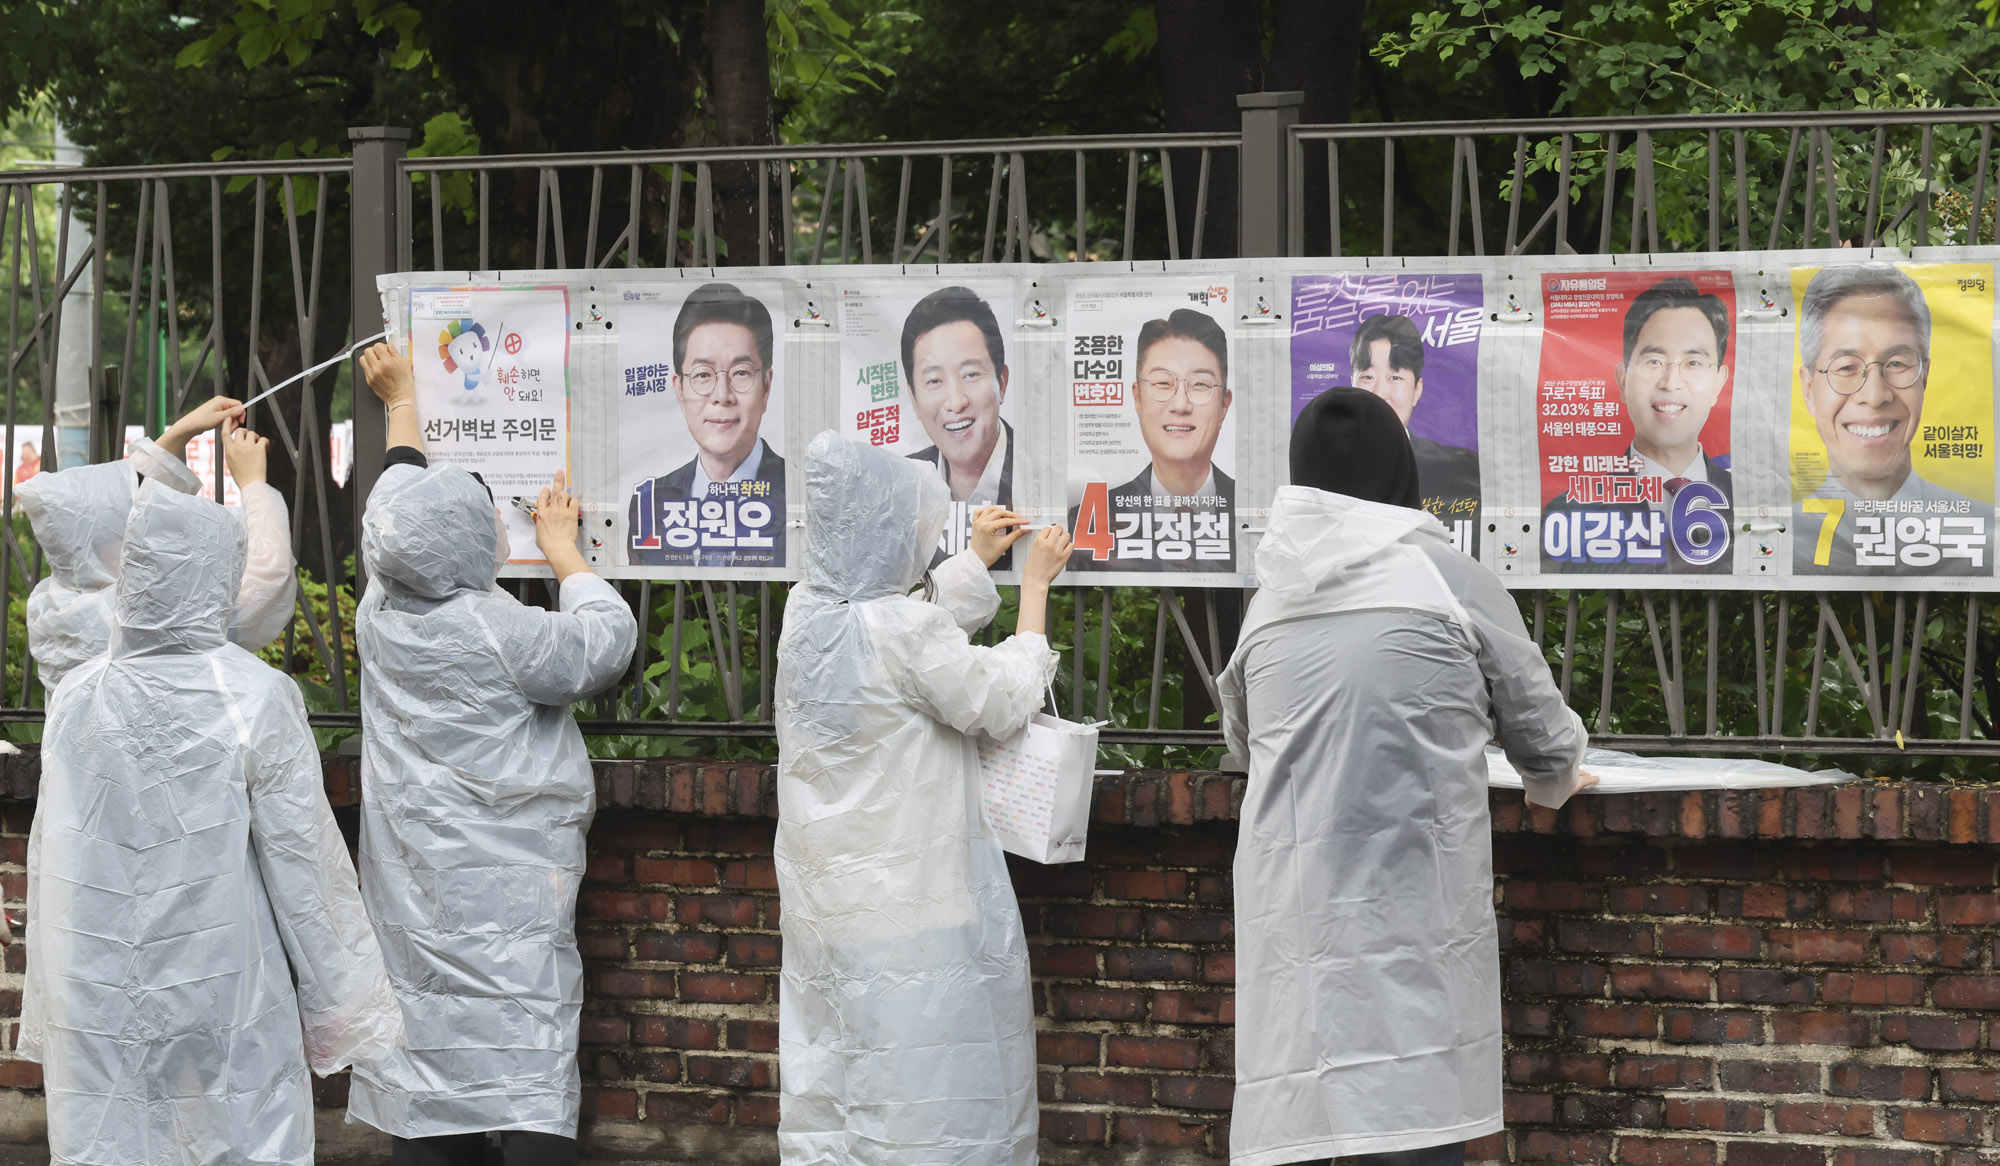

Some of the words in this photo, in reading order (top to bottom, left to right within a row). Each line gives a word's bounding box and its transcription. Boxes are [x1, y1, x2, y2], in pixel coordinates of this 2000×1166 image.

[1560, 278, 1607, 292] 자유통일당
[1957, 278, 1986, 291] 정의당
[1397, 275, 1456, 319] 없는
[1421, 306, 1483, 349] 서울
[1074, 335, 1123, 356] 조용한
[497, 366, 541, 384] 훼손하면
[625, 367, 635, 383] 일
[636, 363, 669, 381] 잘하는
[857, 361, 898, 386] 시작된
[1074, 360, 1122, 380] 다수의
[504, 387, 515, 402] 안
[518, 389, 543, 402] 돼요!
[625, 377, 667, 397] 서울시장
[871, 380, 900, 403] 변화
[1074, 384, 1122, 405] 변호인
[1542, 387, 1576, 401] 구로구
[1578, 387, 1606, 400] 득표!
[857, 404, 900, 431] 압도적
[1542, 403, 1590, 416] 32.03%
[1593, 402, 1620, 417] 돌풍!
[424, 419, 497, 442] 선거벽보
[502, 418, 557, 442] 주의문
[870, 424, 900, 447] 완성
[1542, 421, 1574, 437] 서울의
[1575, 421, 1621, 437] 태풍으로!
[1923, 426, 1978, 441] 같이살자
[1923, 443, 1983, 458] 서울혁명!
[1548, 455, 1579, 473] 강한
[1583, 455, 1645, 473] 미래보수
[709, 483, 739, 497] 하나씩
[740, 480, 771, 498] 착착!
[1566, 475, 1663, 503] 세대교체
[1115, 495, 1141, 508] 당신의
[1143, 495, 1153, 508] 한
[1154, 495, 1171, 508] 표를
[1173, 495, 1199, 508] 끝까지
[1201, 495, 1227, 508] 지키는
[1448, 497, 1478, 518] 선택
[1853, 500, 1898, 514] 뿌리부터
[1899, 500, 1924, 514] 바꿀
[1925, 500, 1971, 514] 서울시장
[632, 476, 662, 550] 1
[662, 499, 774, 549] 정원오
[1073, 481, 1115, 561] 4
[1115, 511, 1231, 560] 김정철
[1543, 511, 1666, 559] 이강산
[1670, 481, 1731, 566] 6
[1802, 498, 1845, 567] 7
[1853, 516, 1987, 568] 권영국
